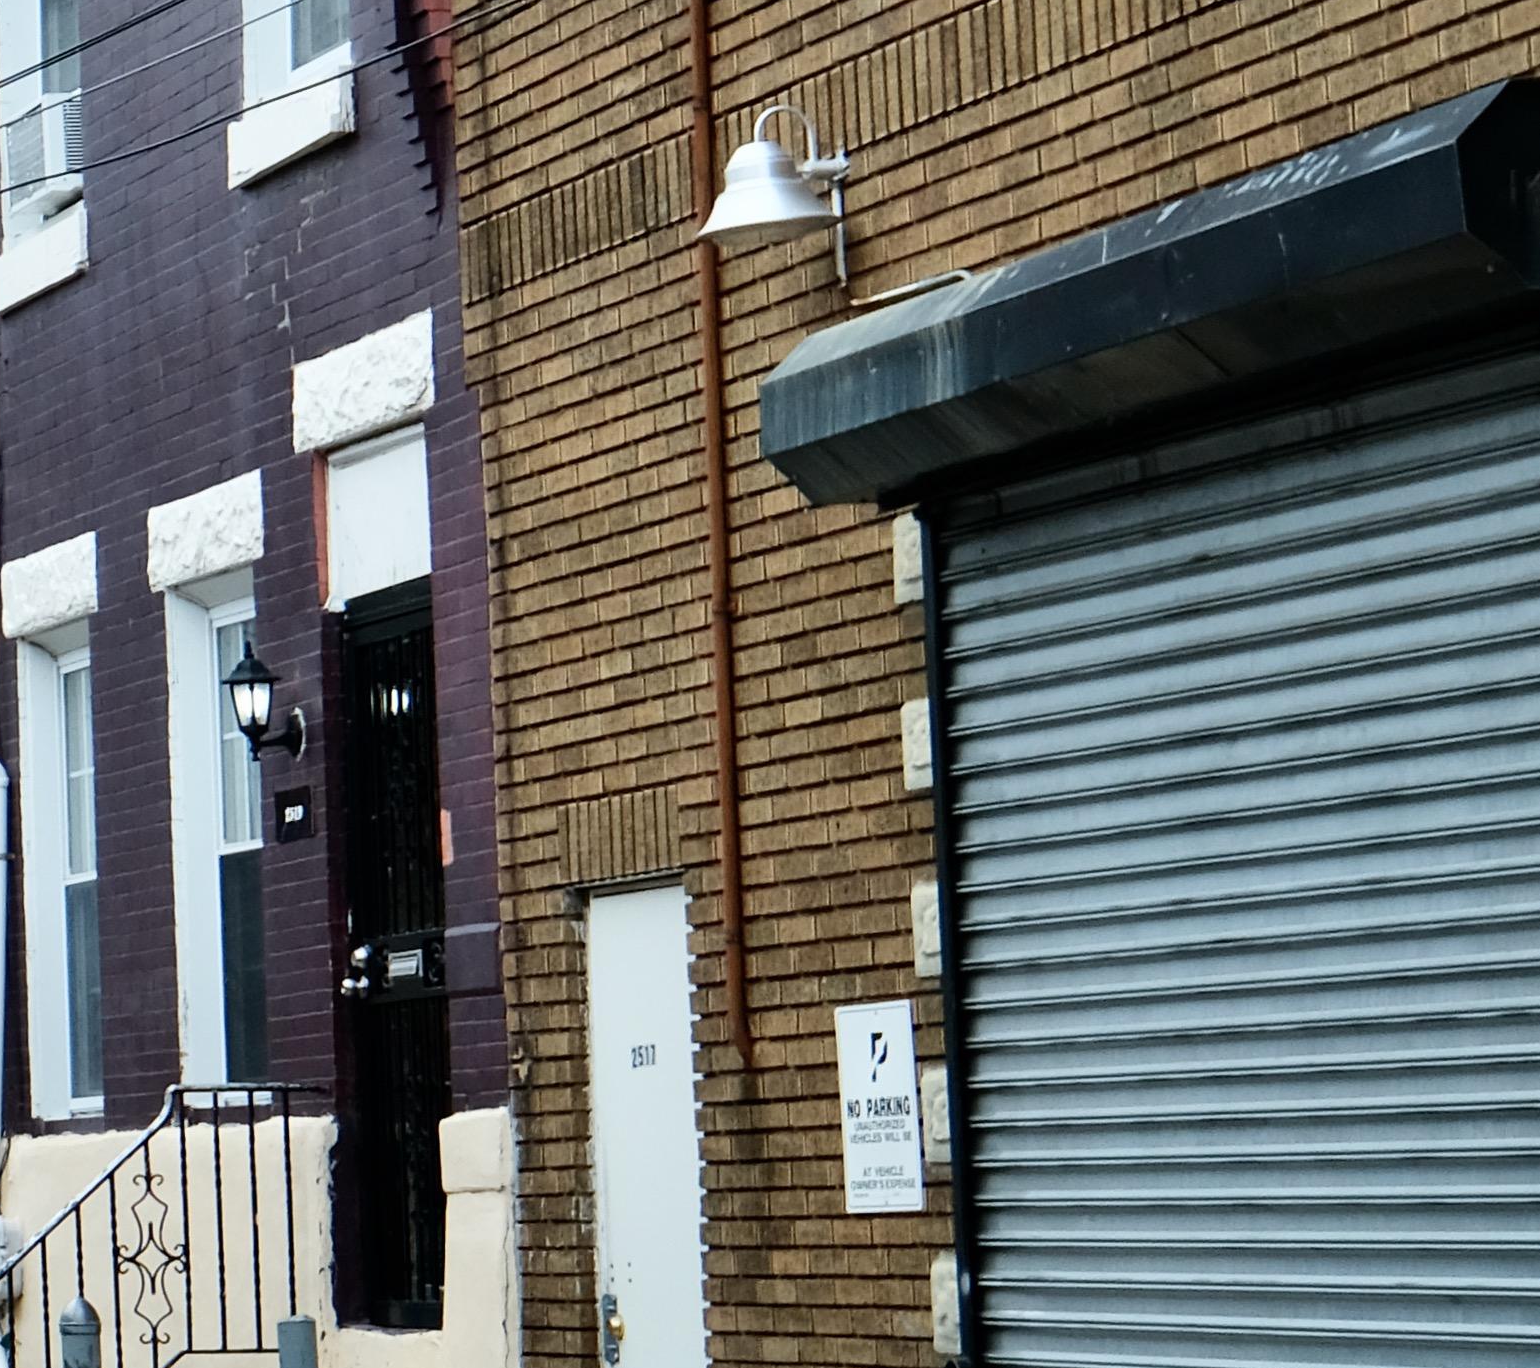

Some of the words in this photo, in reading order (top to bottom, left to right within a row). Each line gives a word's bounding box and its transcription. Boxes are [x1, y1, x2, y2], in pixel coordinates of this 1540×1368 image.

[631, 1044, 656, 1068] 2517
[847, 1099, 861, 1118] NO
[866, 1095, 911, 1118] PARKING
[854, 1119, 906, 1132] UNAUTHORIZED
[850, 1132, 882, 1144] VEHICLES
[885, 1131, 900, 1142] WILL
[863, 1167, 872, 1177] AT
[875, 1165, 904, 1177] VEHICLE
[850, 1179, 883, 1191] OWNER'S
[885, 1177, 916, 1190] EXPENSE
